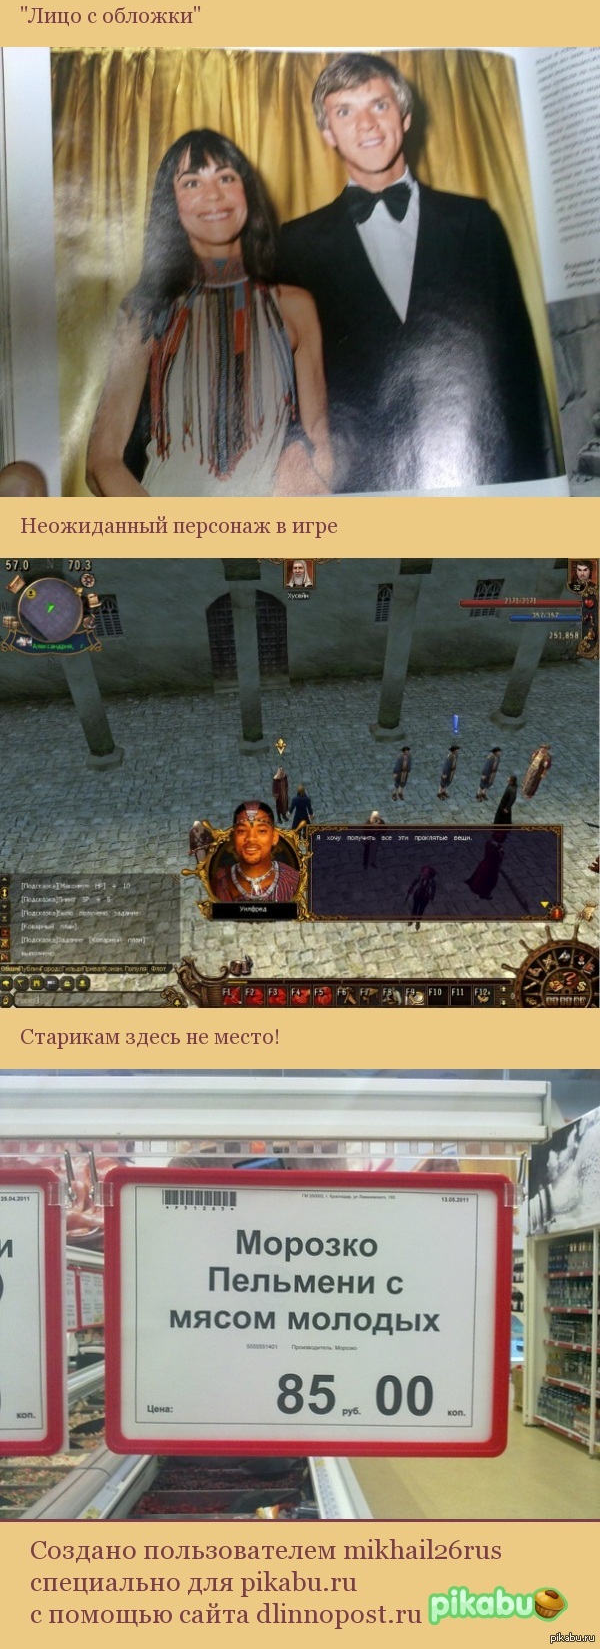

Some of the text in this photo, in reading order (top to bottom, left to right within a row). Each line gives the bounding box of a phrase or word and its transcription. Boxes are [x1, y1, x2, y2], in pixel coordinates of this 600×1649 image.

[5, 559, 92, 571] 57.0 70.3
[428, 988, 464, 996] F10 F11
[236, 1229, 378, 1262] Морозко
[208, 1266, 404, 1295] Пельмени с
[170, 1309, 440, 1336] мясом молодых
[146, 1372, 466, 1418] Цена: 85 руб. 00 коп.
